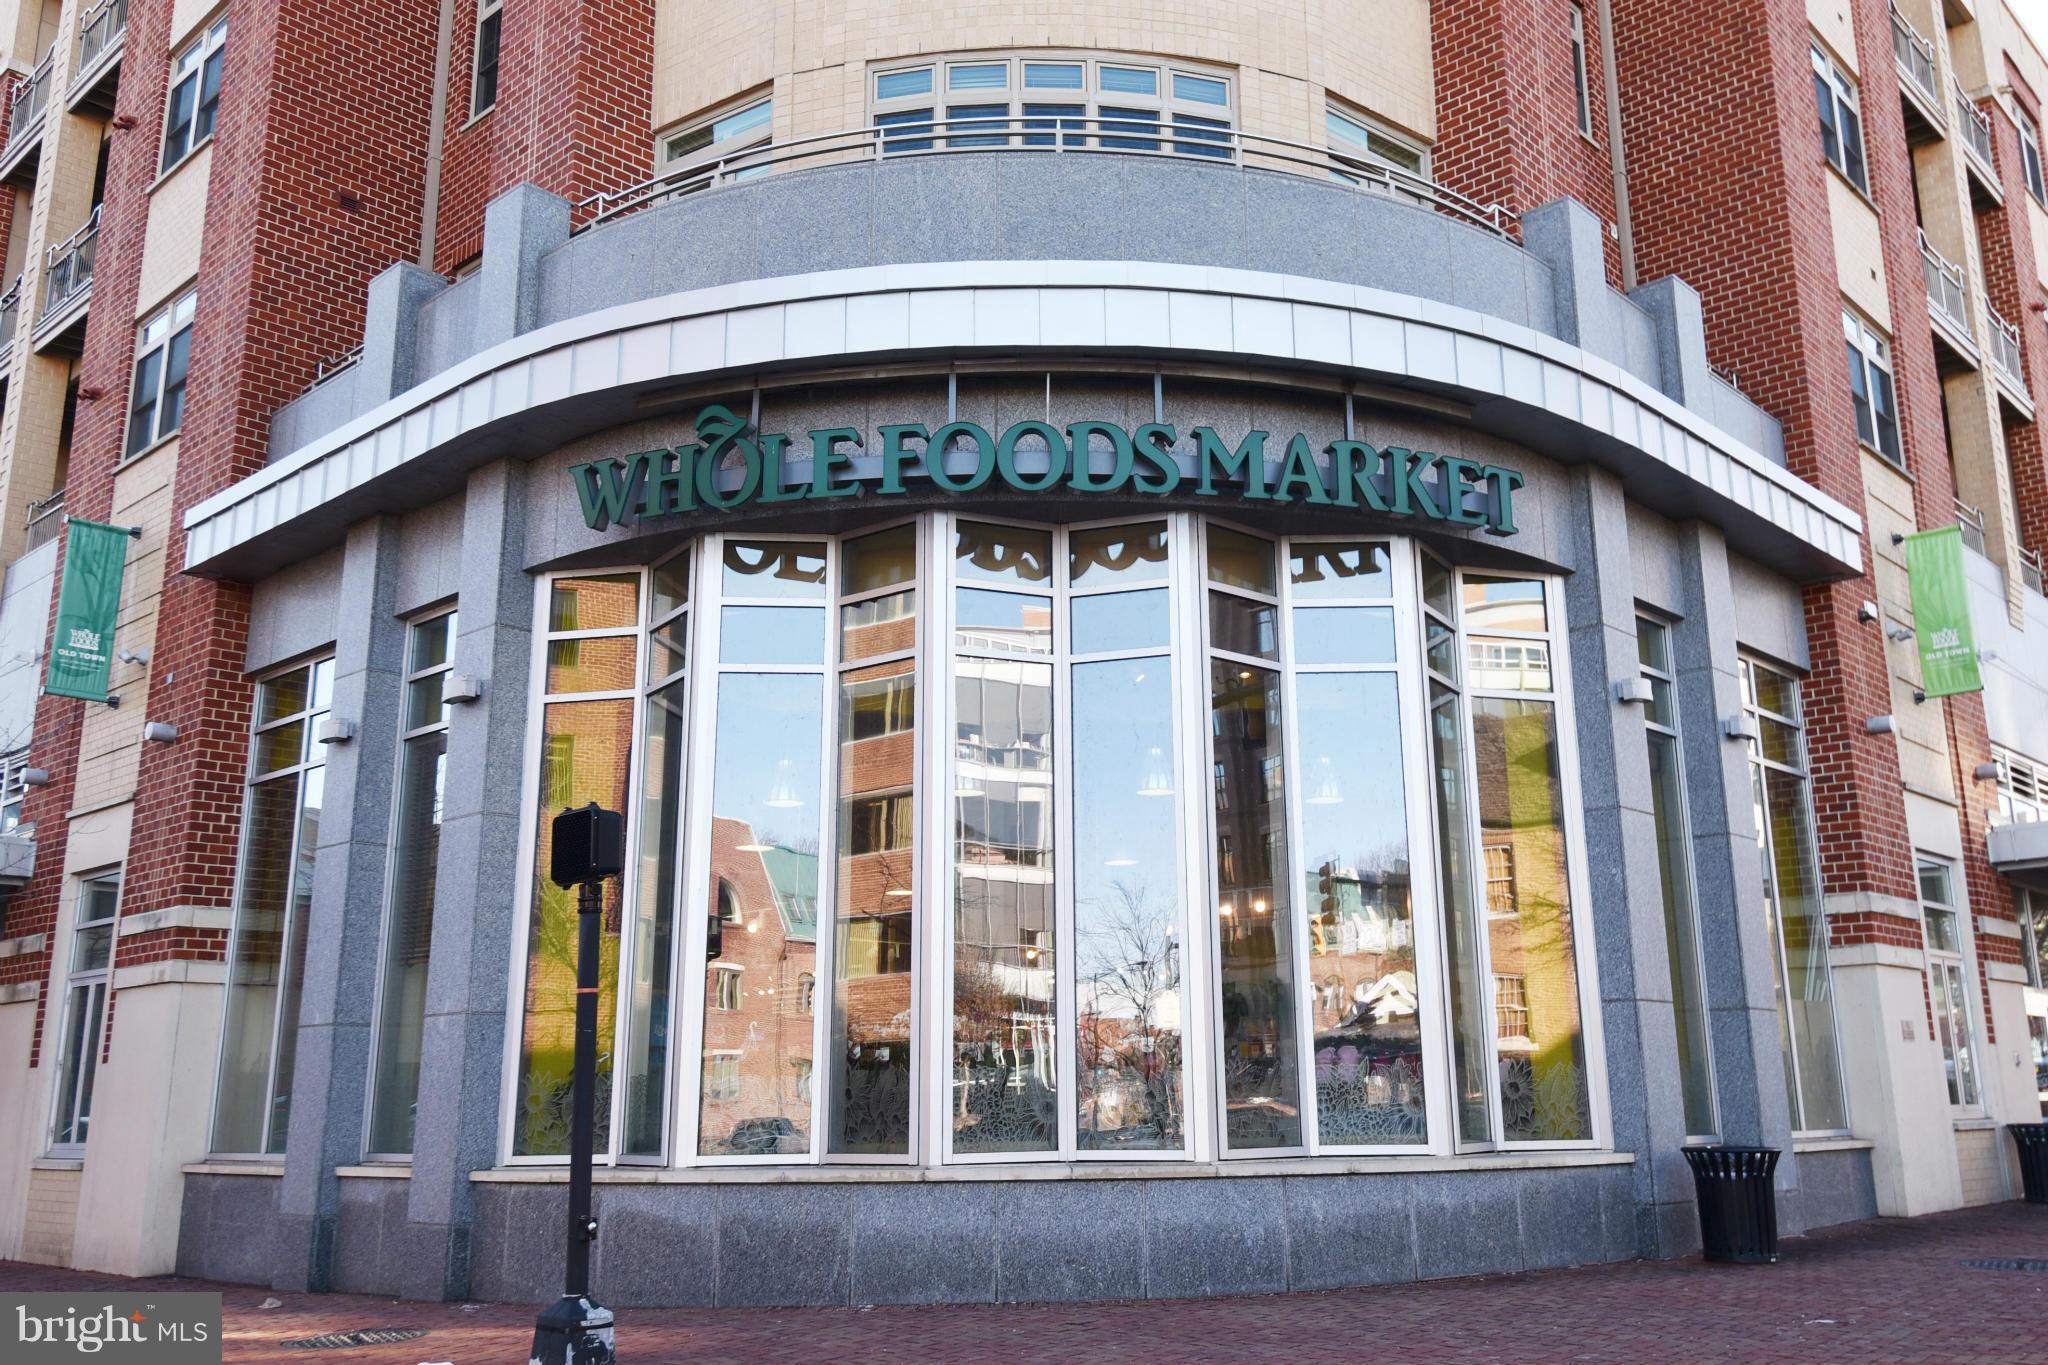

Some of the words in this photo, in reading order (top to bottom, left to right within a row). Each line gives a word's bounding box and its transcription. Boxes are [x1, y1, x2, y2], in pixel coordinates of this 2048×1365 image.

[569, 404, 864, 532] WHOLE
[877, 420, 1183, 495] FOODS
[1190, 425, 1526, 538] MARKET
[58, 648, 77, 657] OLD
[79, 652, 106, 662] TOWN
[1926, 651, 1942, 659] OLD
[1944, 648, 1970, 656] TOWN
